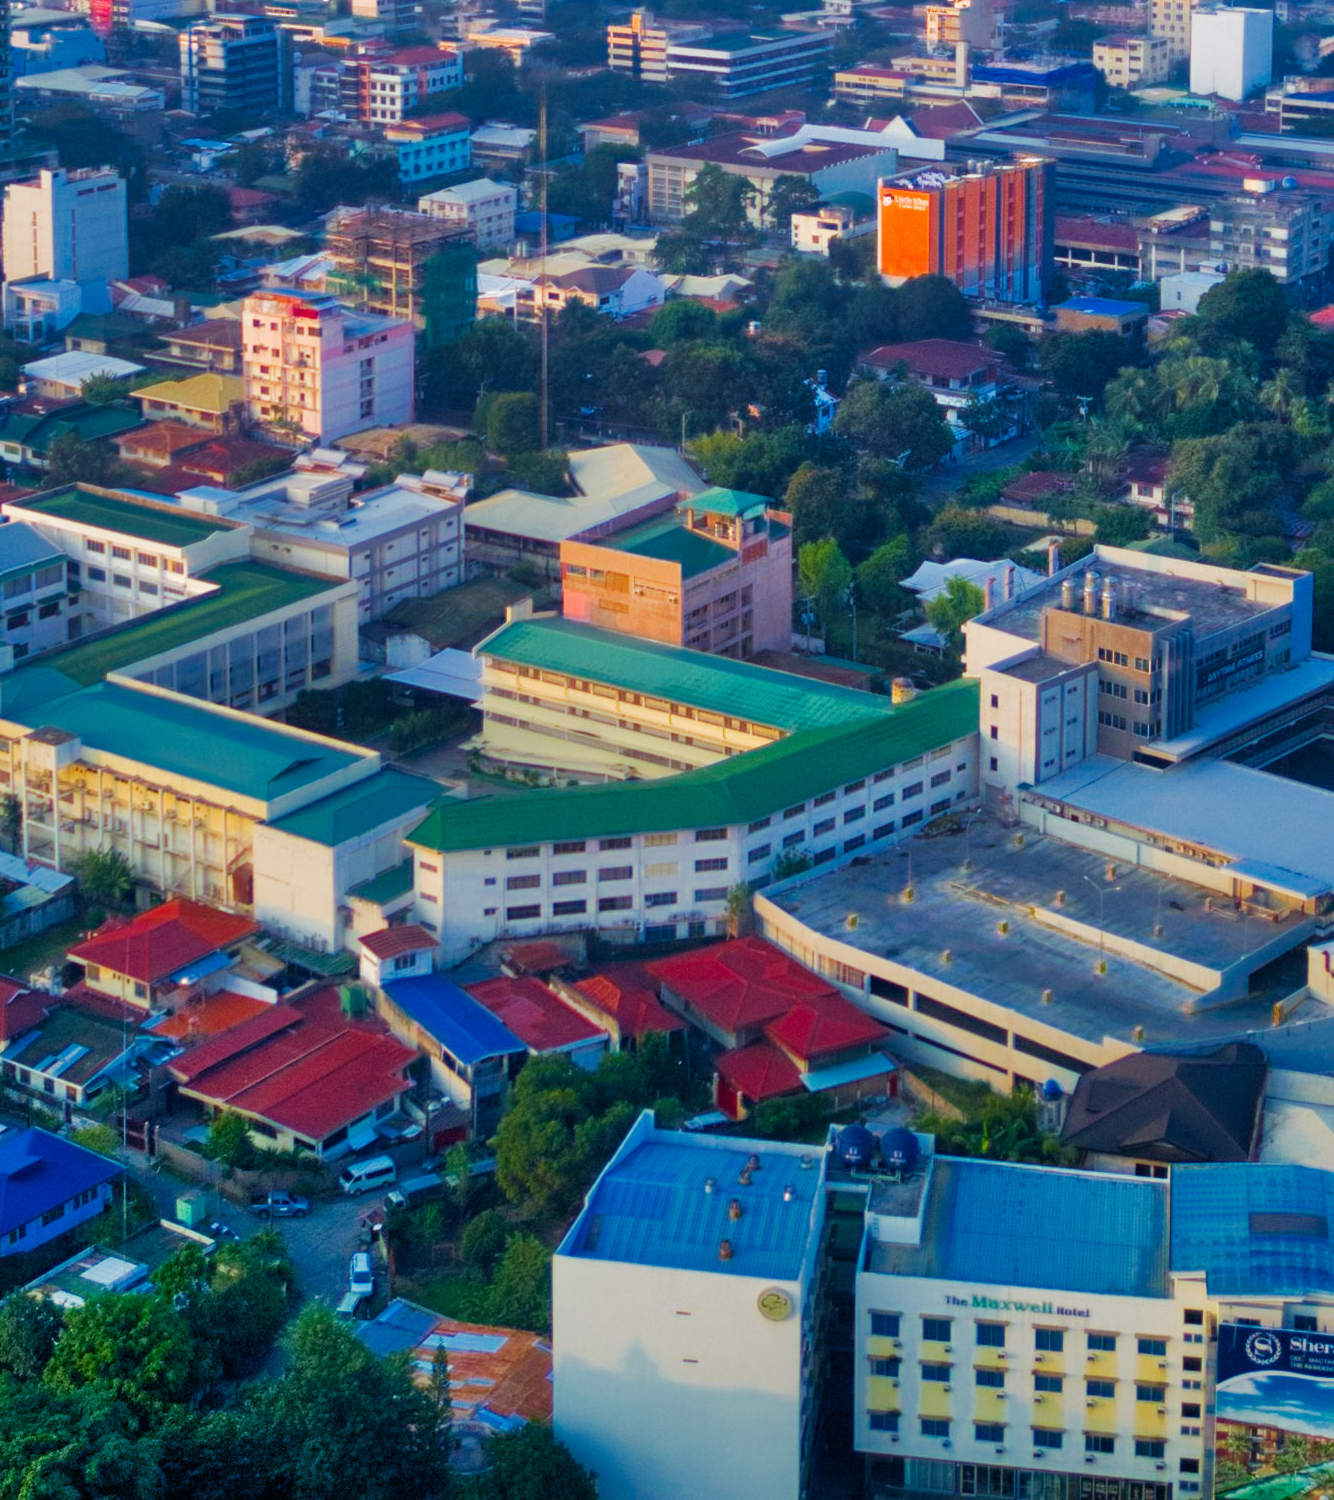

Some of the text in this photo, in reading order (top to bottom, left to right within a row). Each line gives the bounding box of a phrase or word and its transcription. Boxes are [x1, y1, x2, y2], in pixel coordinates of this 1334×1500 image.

[1237, 650, 1263, 669] FITNESS
[945, 1295, 1090, 1318] The Maxwell Hotel
